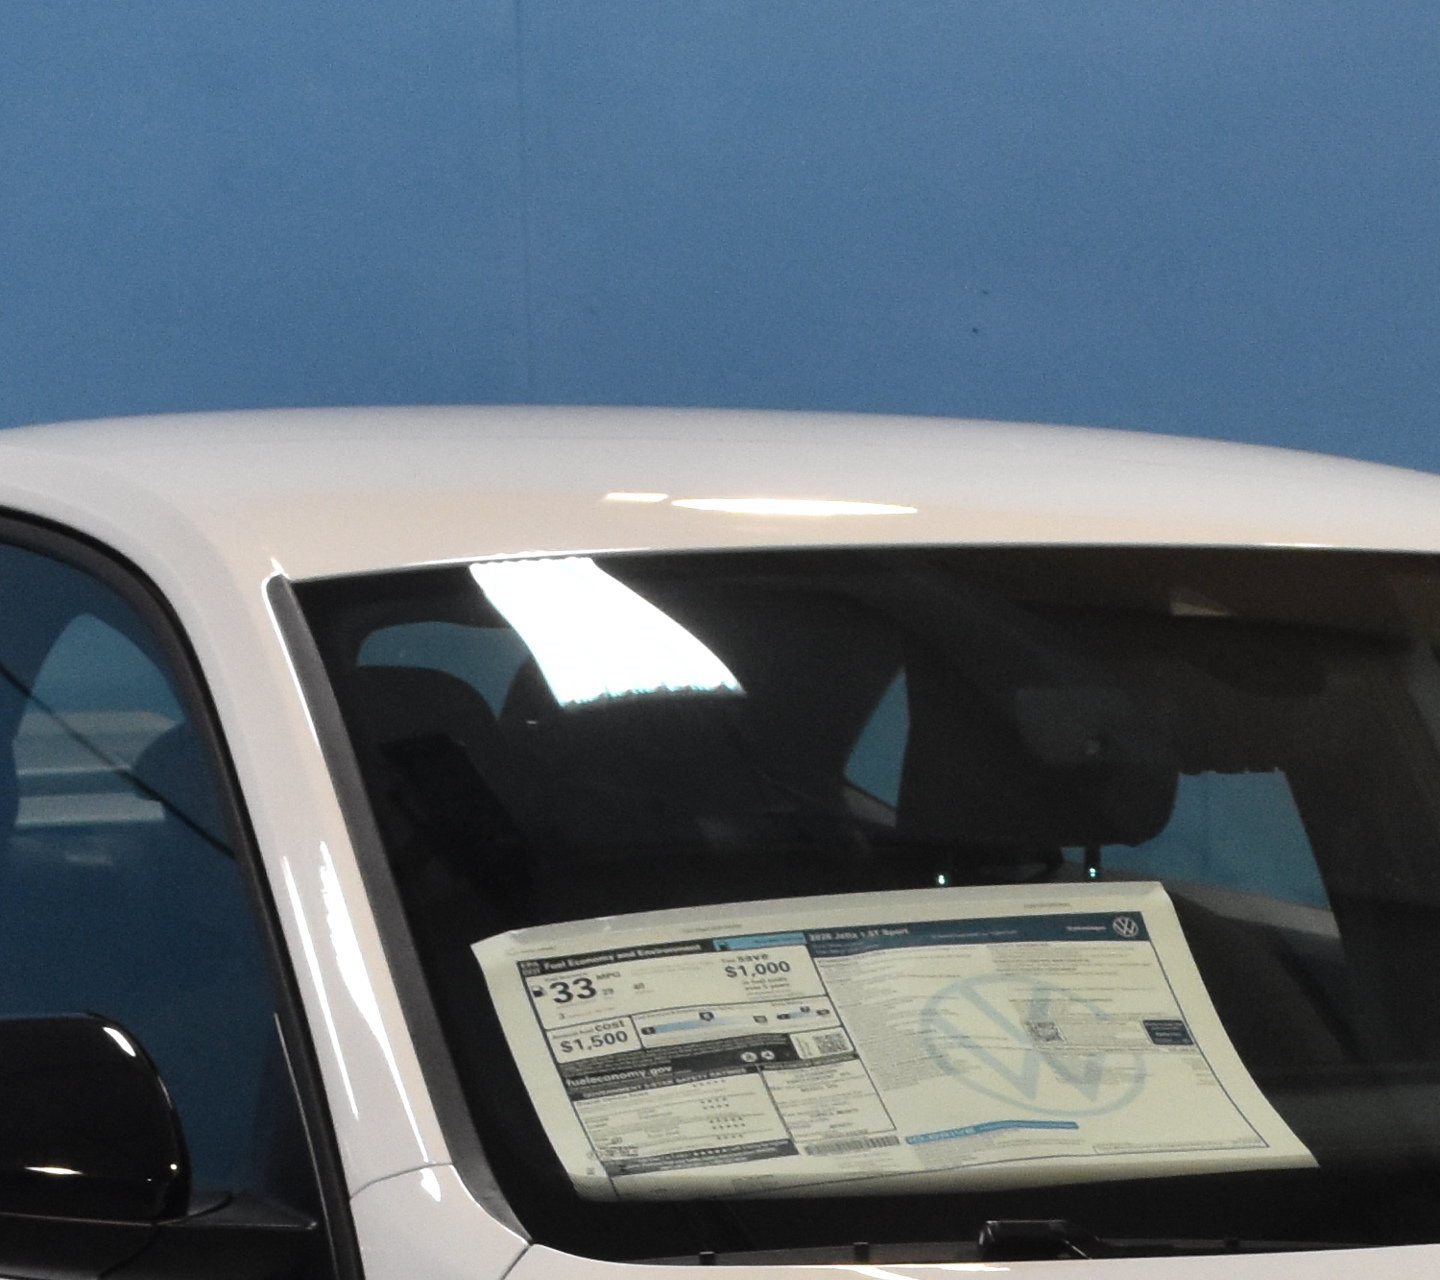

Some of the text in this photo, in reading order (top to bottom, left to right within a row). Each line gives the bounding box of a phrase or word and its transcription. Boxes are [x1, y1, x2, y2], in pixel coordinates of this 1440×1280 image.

[543, 944, 702, 970] Fuel Economy and Environment
[724, 961, 791, 978] $1,000
[549, 977, 597, 1004] 33
[596, 971, 621, 980] MPG
[594, 1020, 625, 1032] cost
[559, 1030, 628, 1054] $1,500
[566, 1065, 673, 1087] fueleconomy.gov
